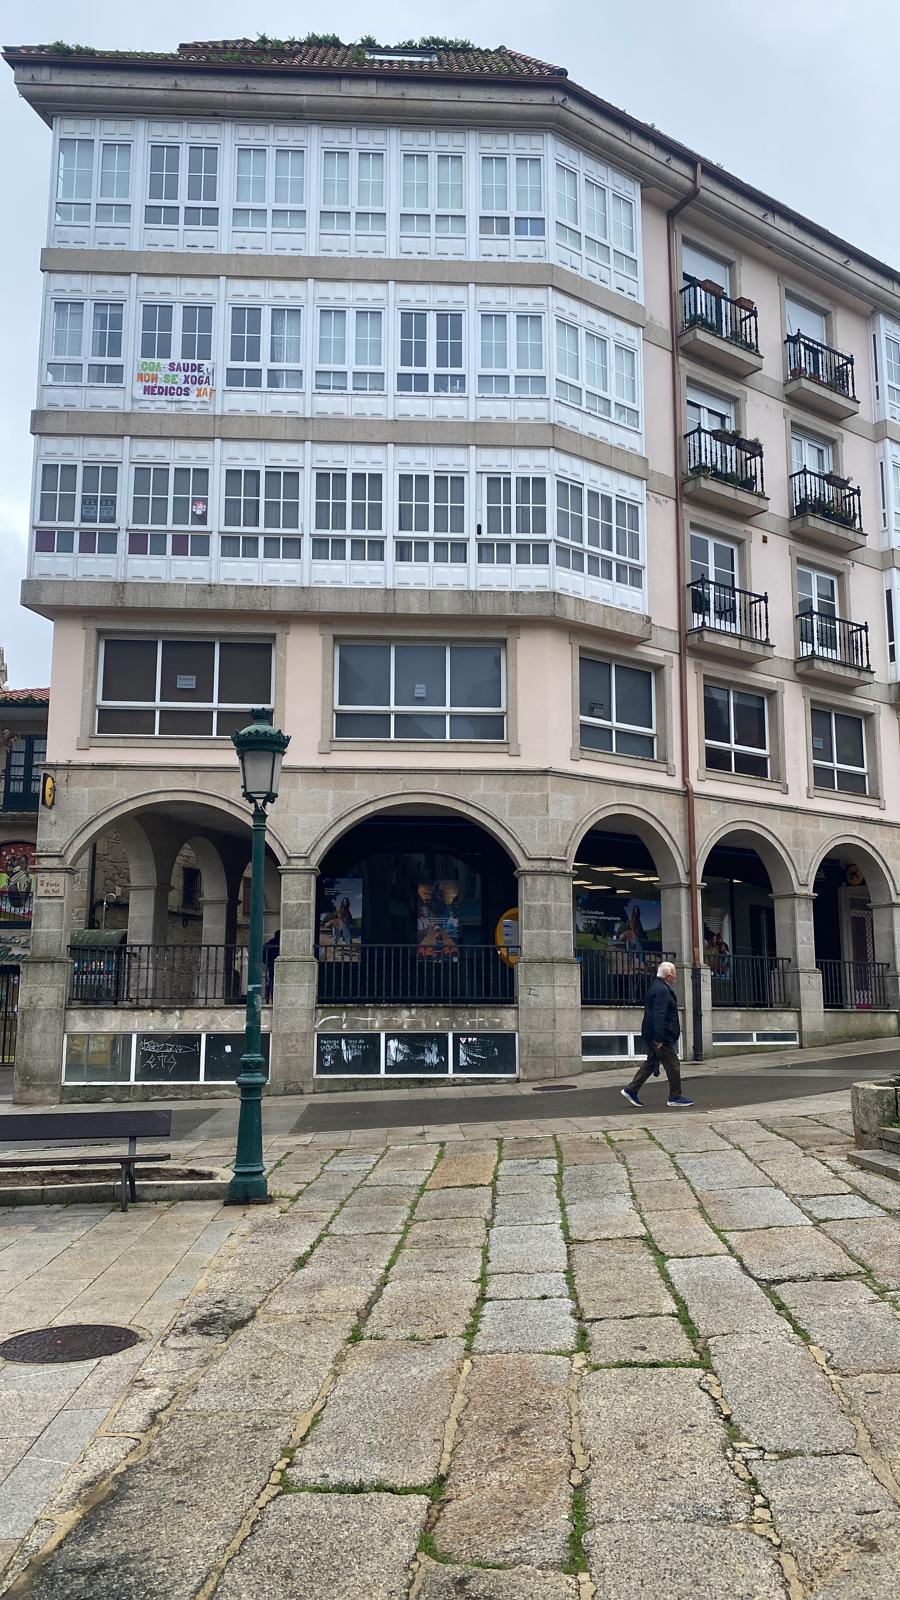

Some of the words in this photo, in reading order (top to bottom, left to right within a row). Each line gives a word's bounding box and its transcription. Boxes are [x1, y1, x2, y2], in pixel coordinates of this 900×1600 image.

[136, 372, 158, 383] NON
[163, 373, 178, 384] SE
[183, 374, 210, 385] XOGA
[143, 384, 190, 396] MÉDICOS
